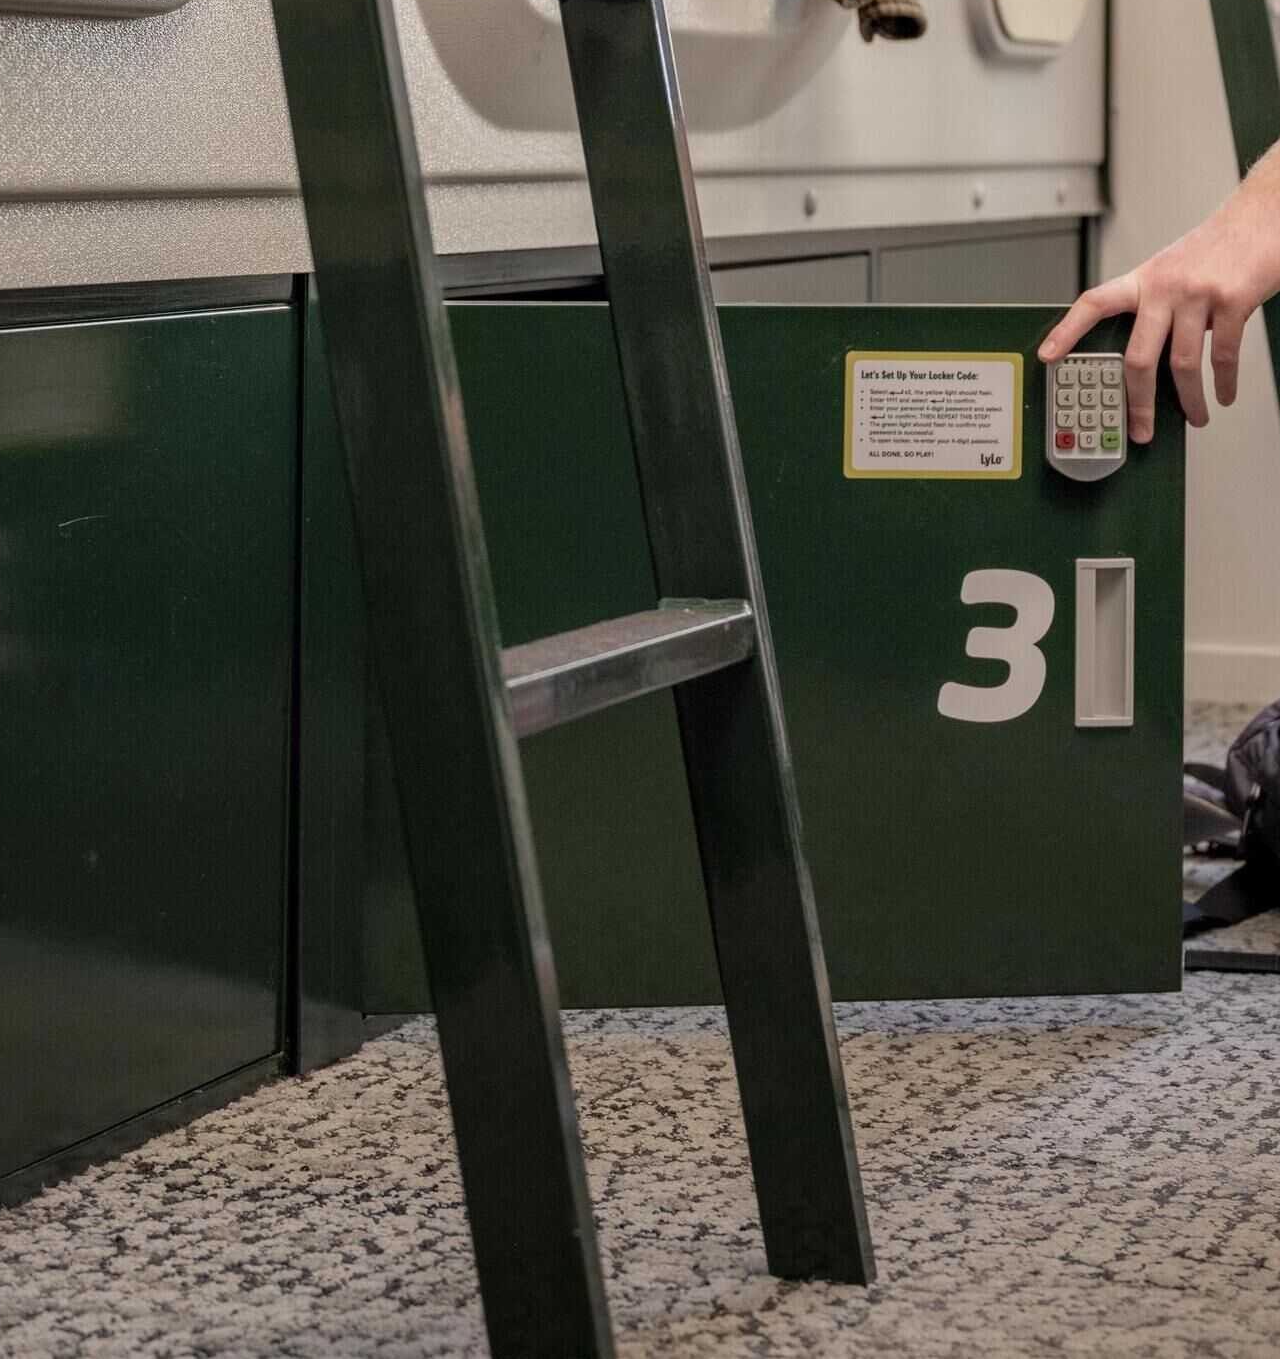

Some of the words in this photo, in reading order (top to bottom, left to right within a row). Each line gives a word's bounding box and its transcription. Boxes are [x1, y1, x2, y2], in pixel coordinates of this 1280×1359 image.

[861, 370, 879, 380] Let's
[882, 370, 894, 380] Set
[897, 370, 907, 382] Up
[909, 370, 926, 380] Your
[929, 370, 954, 380] Locker
[957, 370, 979, 380] Code:
[937, 568, 1055, 723] 3
